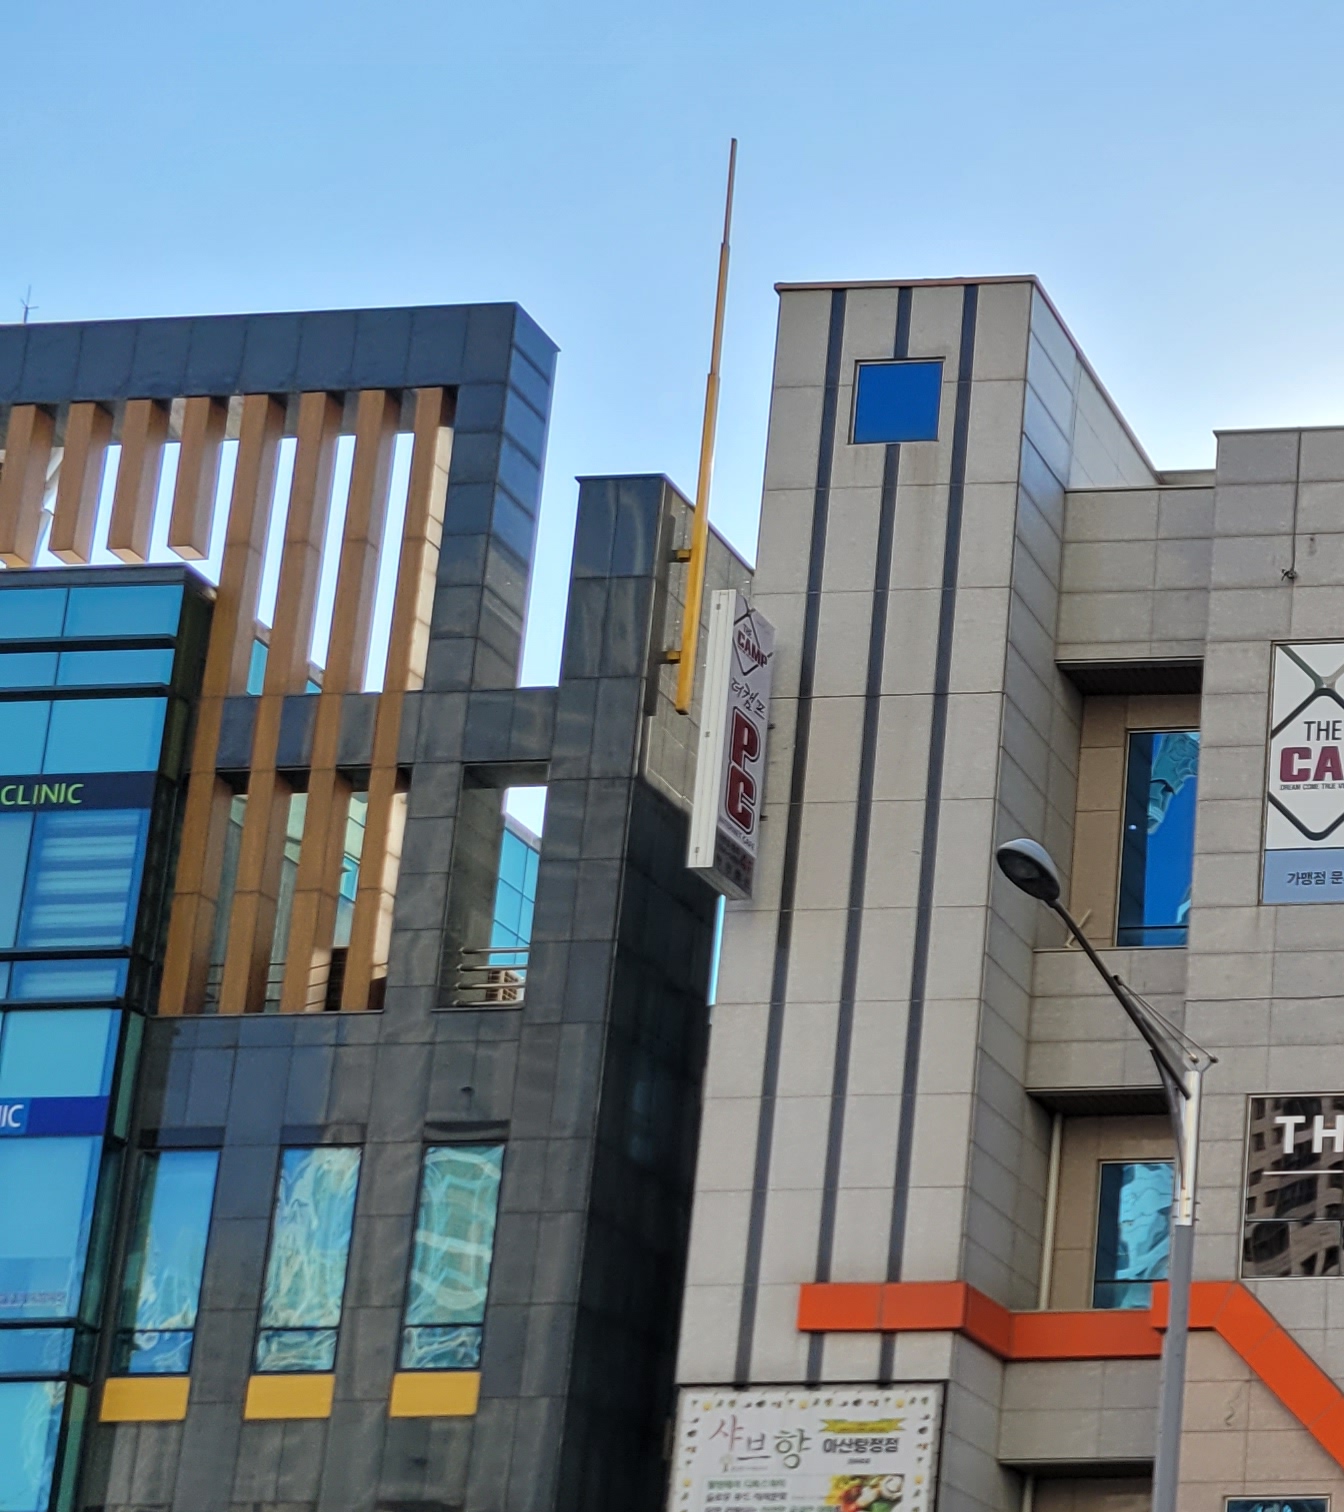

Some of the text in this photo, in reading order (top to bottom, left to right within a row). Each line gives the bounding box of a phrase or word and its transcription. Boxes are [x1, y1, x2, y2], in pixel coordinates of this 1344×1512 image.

[737, 630, 769, 668] CAMP
[1303, 720, 1343, 741] THE
[1286, 871, 1328, 887] 가맹점
[709, 1414, 813, 1470] 샤브향
